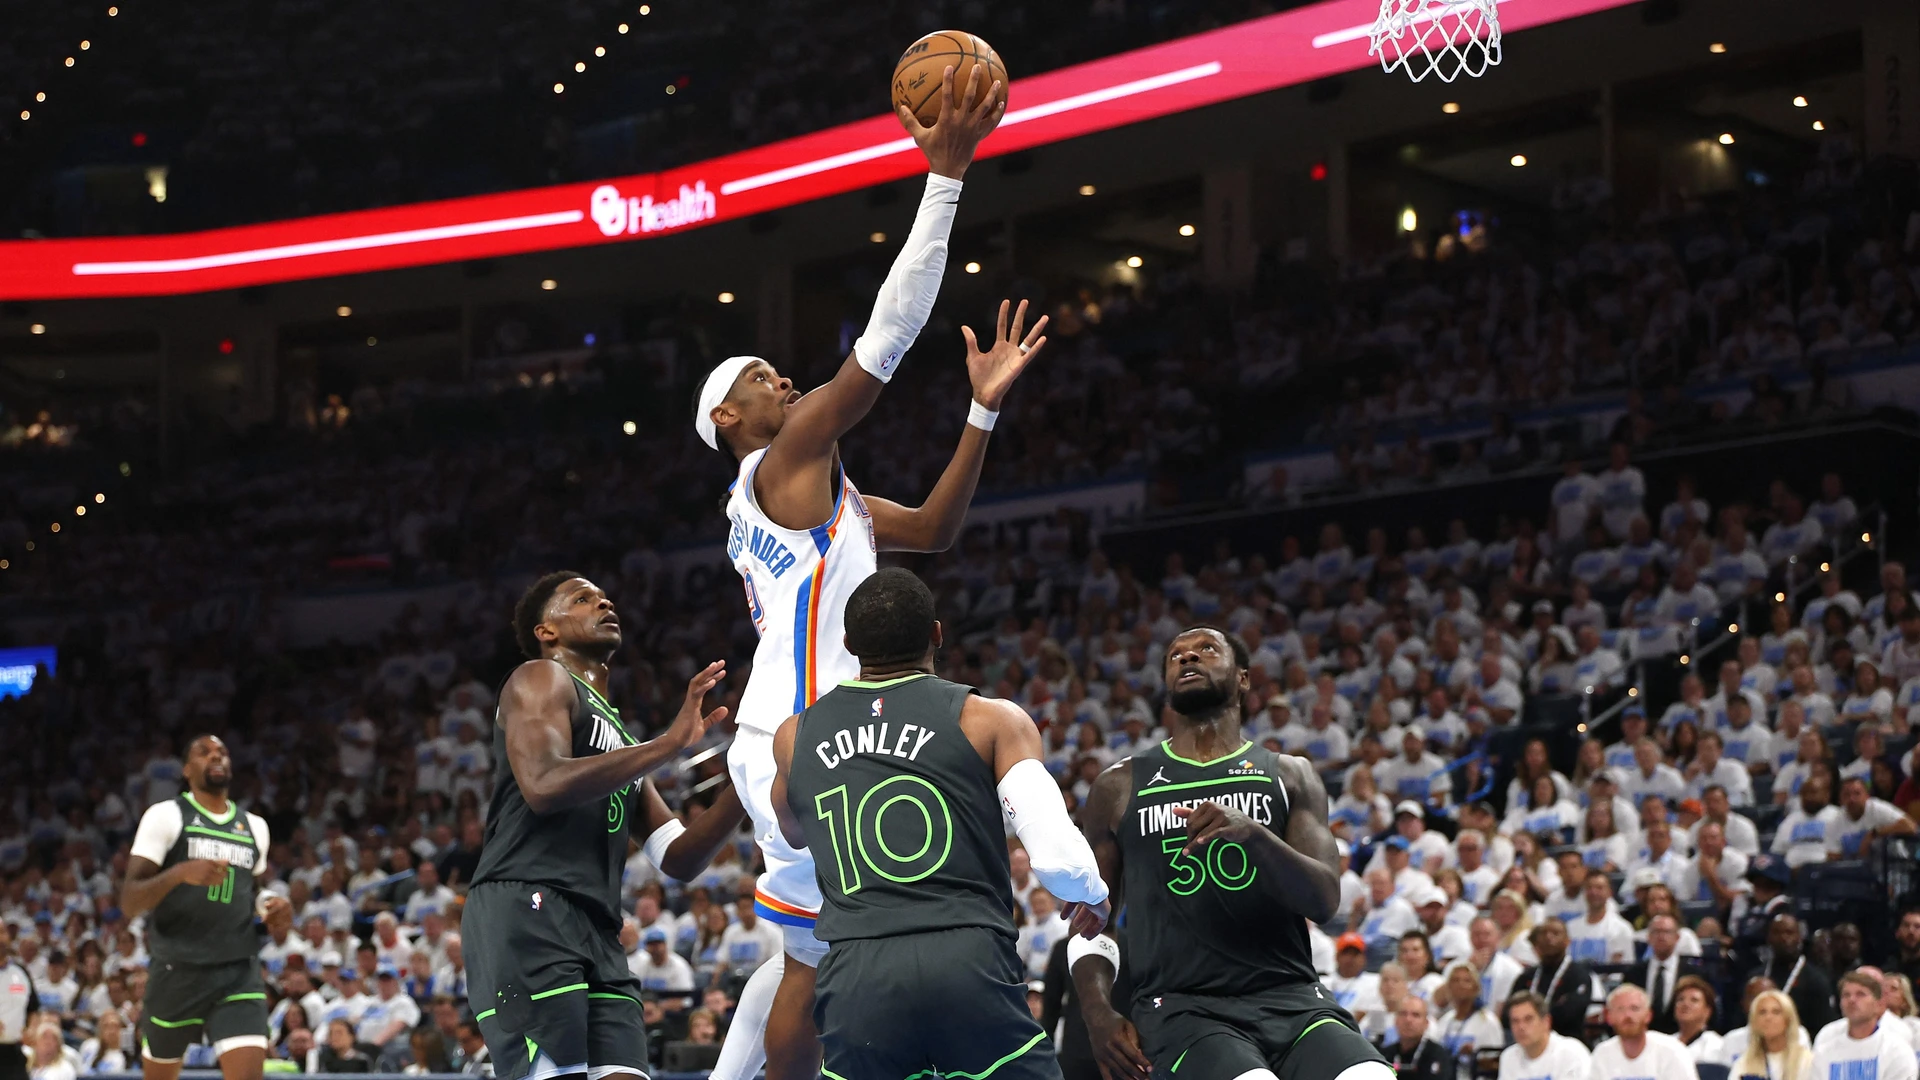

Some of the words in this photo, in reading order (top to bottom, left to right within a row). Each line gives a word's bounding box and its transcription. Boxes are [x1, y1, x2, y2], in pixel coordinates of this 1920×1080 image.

[627, 179, 717, 235] Health
[815, 722, 936, 770] CONLEY
[1227, 767, 1266, 776] sezzle
[814, 774, 954, 896] 10
[1137, 791, 1273, 838] TIMBEOLVES
[1161, 835, 1258, 896] 30
